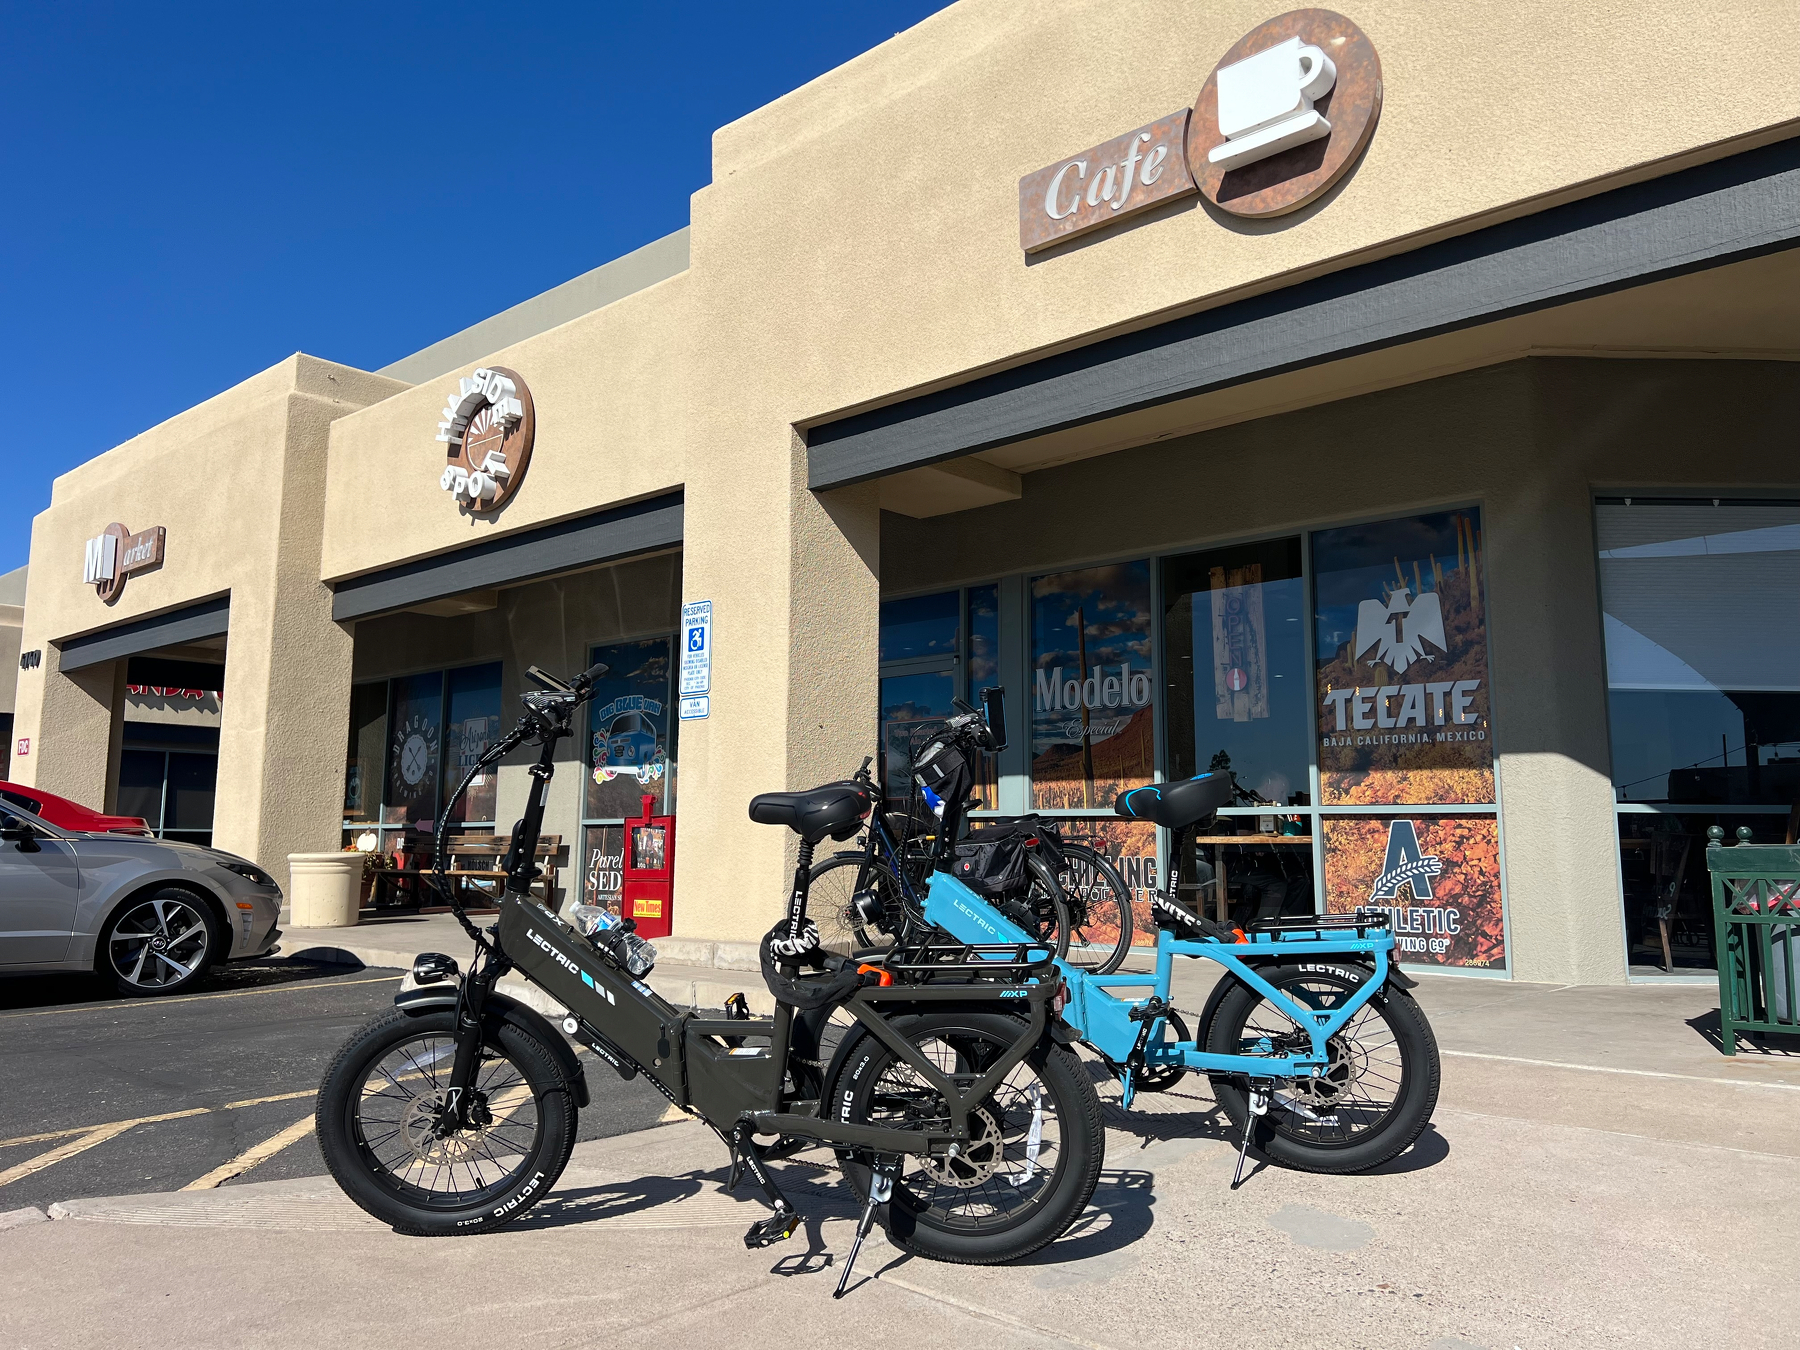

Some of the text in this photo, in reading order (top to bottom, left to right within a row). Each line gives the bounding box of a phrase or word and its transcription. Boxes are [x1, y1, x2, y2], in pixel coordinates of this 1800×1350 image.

[1045, 130, 1168, 222] Cafe
[435, 367, 523, 444] HILLSIDE
[440, 450, 511, 503] SPOT
[684, 604, 710, 616] RESERVED
[685, 615, 708, 627] PARKING
[1226, 597, 1242, 667] OPEN
[1036, 661, 1151, 713] Modelo
[599, 694, 662, 722] BIG BLUE VAN
[1323, 679, 1481, 731] TECATE
[393, 714, 438, 755] DRAGOON
[1062, 718, 1122, 742] Especial
[1323, 730, 1485, 747] BAJA CALIFORNIA, MEXICO
[18, 739, 29, 754] FDC
[456, 752, 482, 767] LIG
[589, 848, 624, 869] Purel
[588, 870, 623, 891] SED
[635, 900, 645, 912] New
[645, 901, 661, 914] Times
[789, 890, 803, 940] LECTRIC
[953, 899, 996, 935] LECTRIC
[525, 928, 580, 975] LECTRIC
[1298, 963, 1360, 983] LECTRIC
[591, 1042, 620, 1067] LECTRIC
[493, 1171, 545, 1217] LECTRIC
